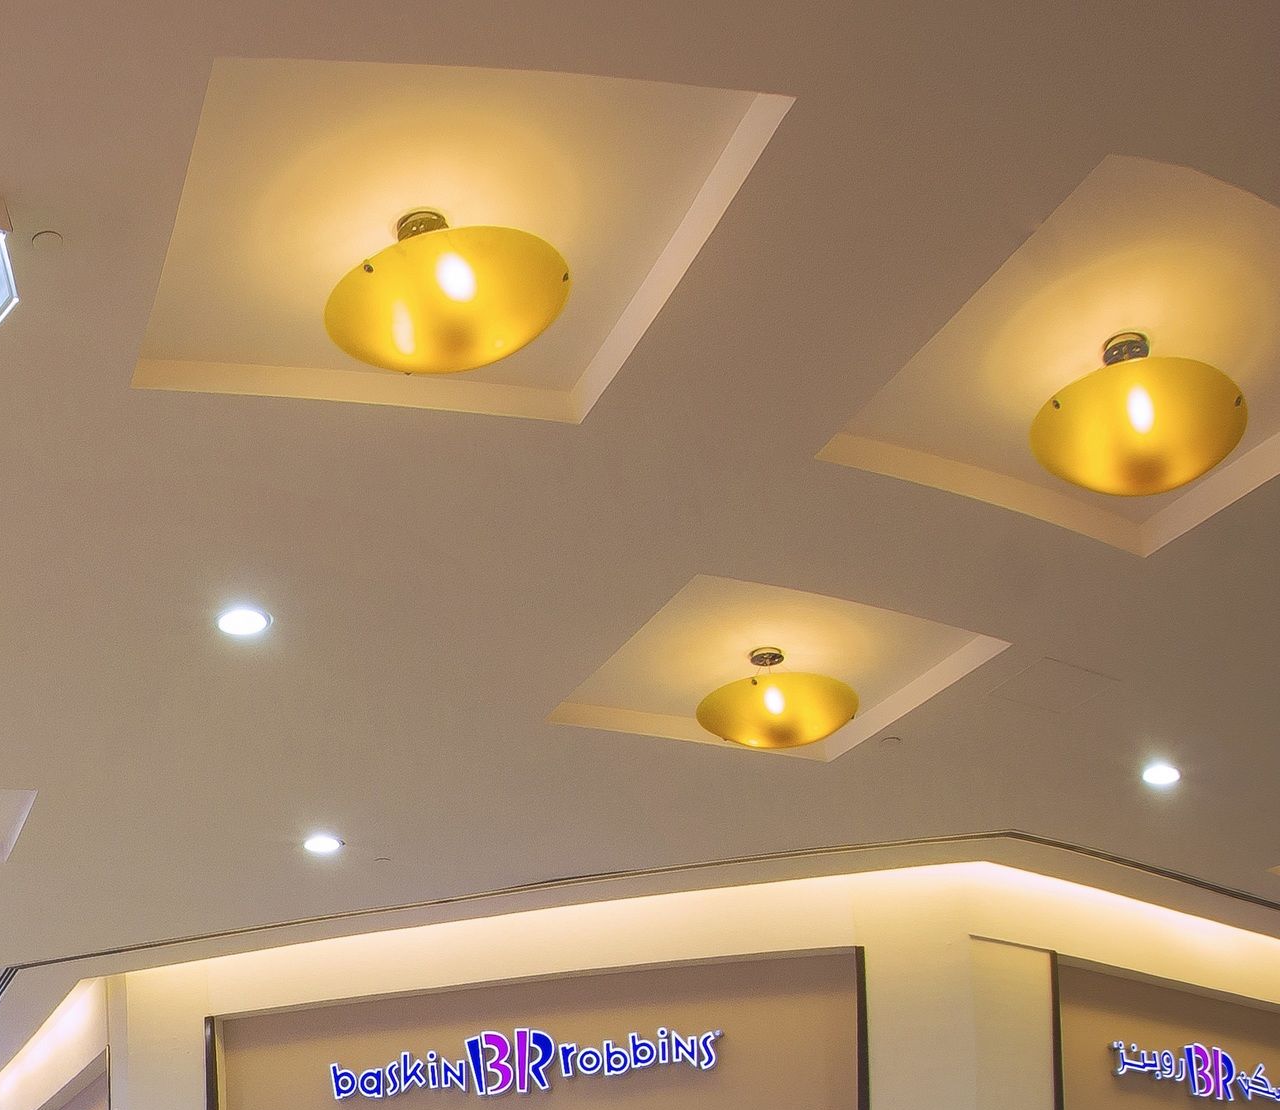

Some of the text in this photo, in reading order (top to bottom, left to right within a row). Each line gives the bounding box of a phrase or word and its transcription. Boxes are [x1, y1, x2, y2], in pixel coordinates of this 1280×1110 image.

[330, 1026, 718, 1100] baskin BR robbins
